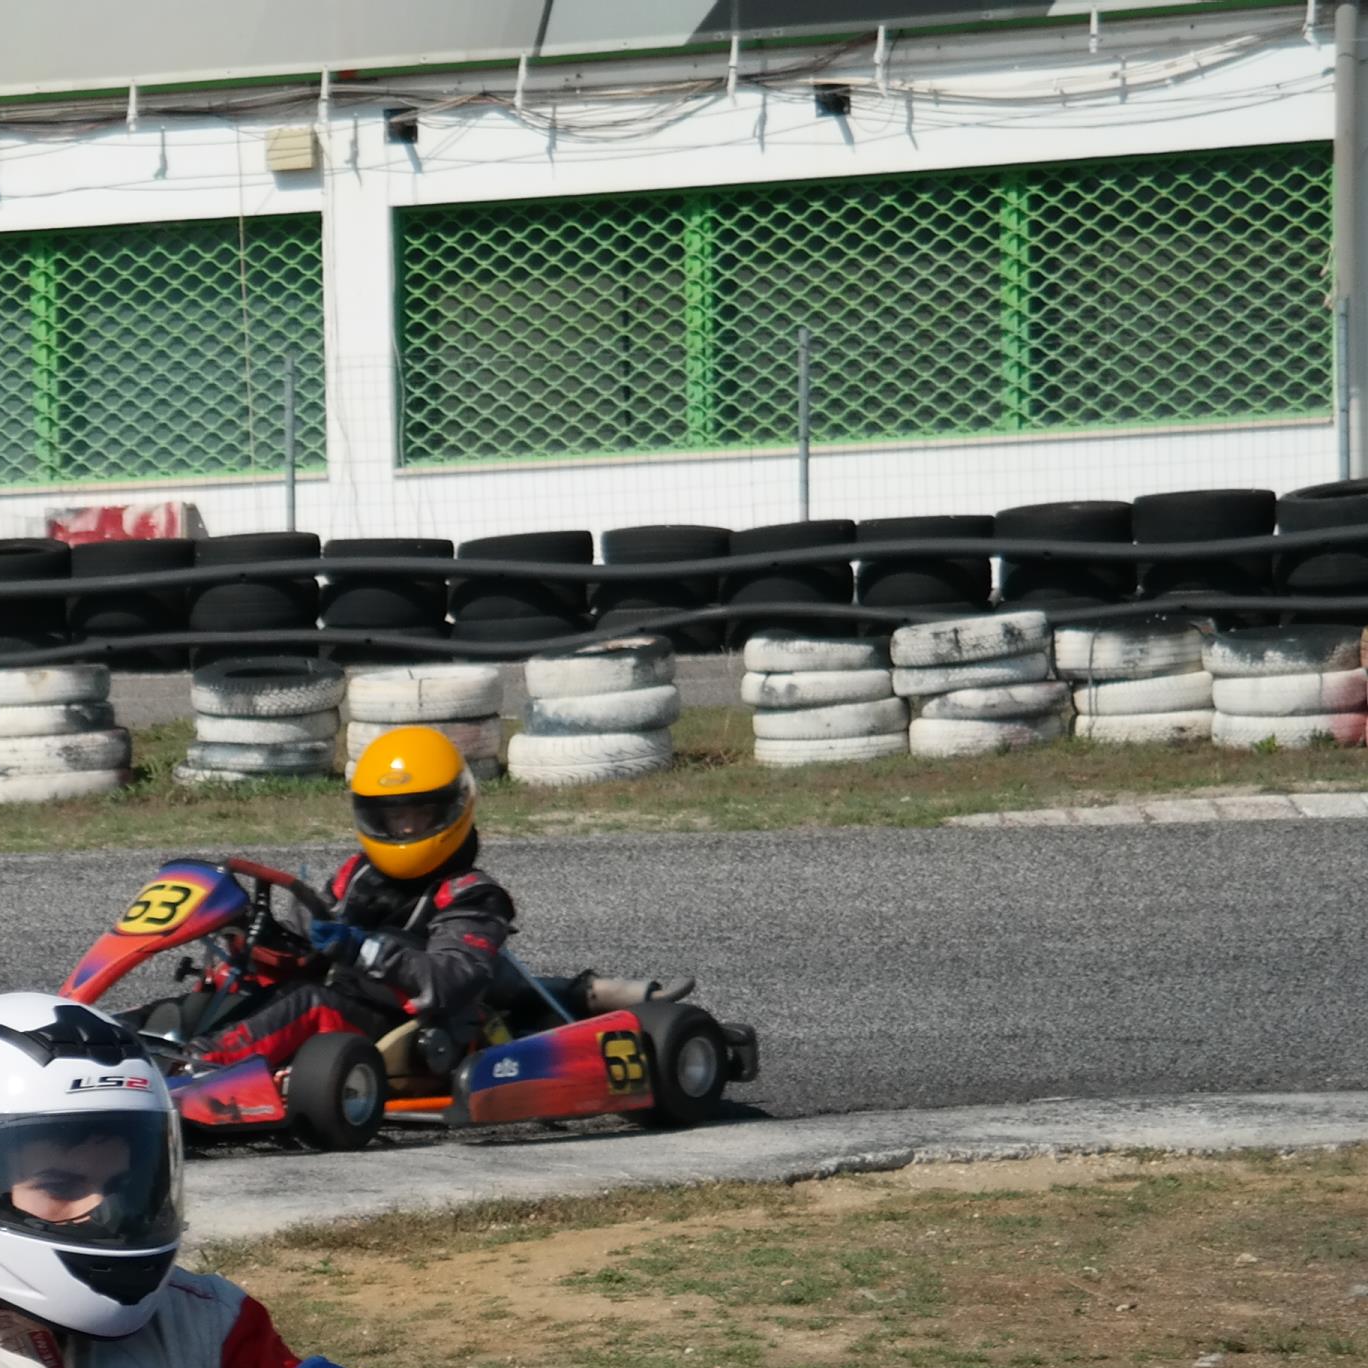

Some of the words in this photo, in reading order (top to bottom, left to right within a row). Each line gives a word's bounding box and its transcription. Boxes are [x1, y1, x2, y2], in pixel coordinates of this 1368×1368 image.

[122, 884, 192, 926] 63
[600, 1029, 648, 1091] 63
[69, 1075, 151, 1091] LS2
